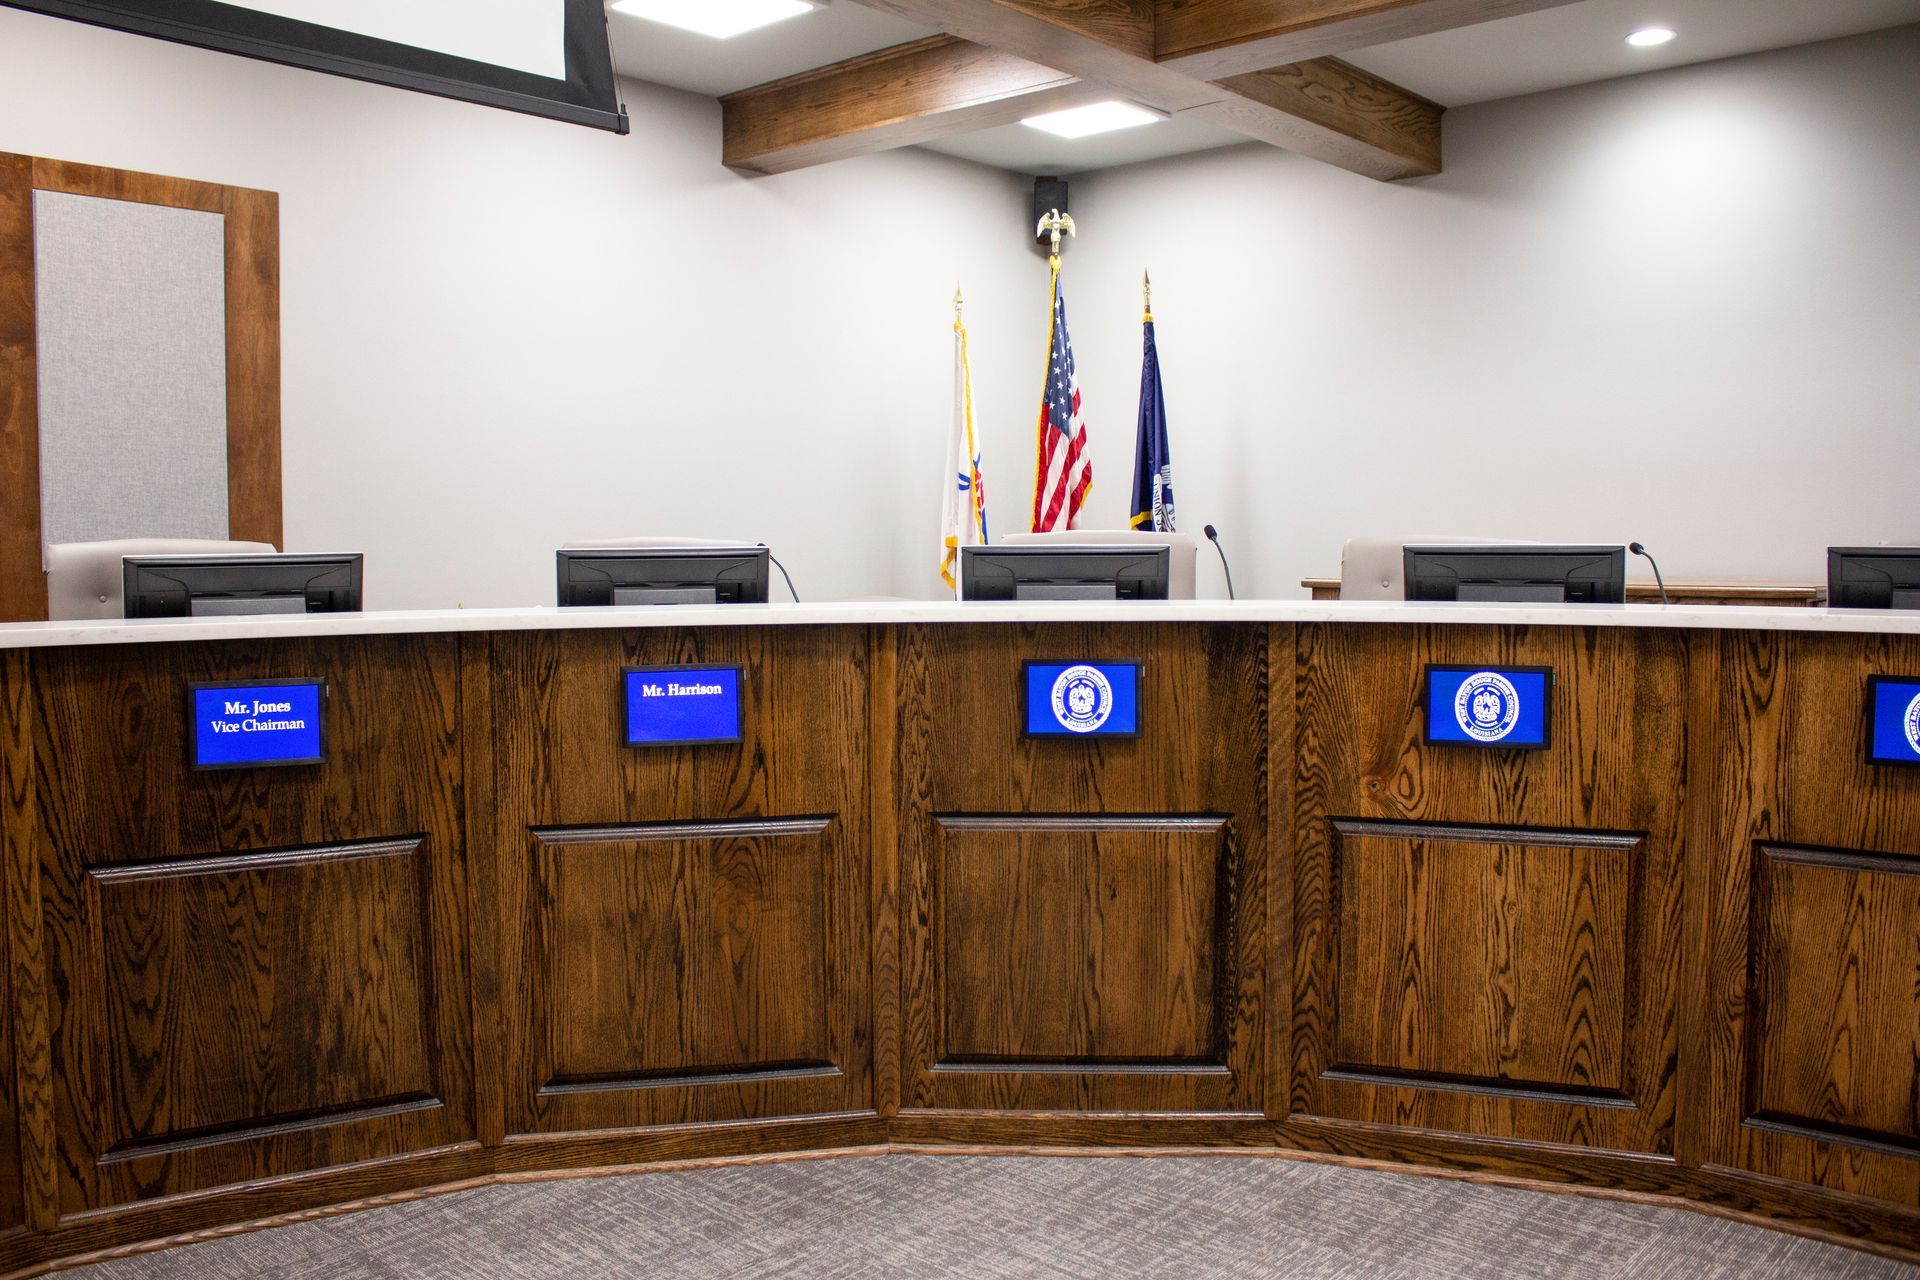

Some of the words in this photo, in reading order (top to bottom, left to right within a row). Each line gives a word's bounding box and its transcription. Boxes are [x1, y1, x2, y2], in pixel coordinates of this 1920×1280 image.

[642, 684, 666, 697] Mr.
[667, 683, 722, 696] Harrison
[1471, 677, 1493, 688] ROUGE
[1099, 687, 1108, 714] COUNCIL
[1460, 683, 1474, 705] BATON
[224, 701, 250, 715] Mr.
[252, 700, 291, 717] Jones
[1460, 705, 1468, 723] WEST
[1504, 694, 1515, 723] COUNCIL
[211, 720, 240, 733] Vice
[241, 719, 305, 732] Chairman
[1469, 725, 1504, 737] LOUISIANA
